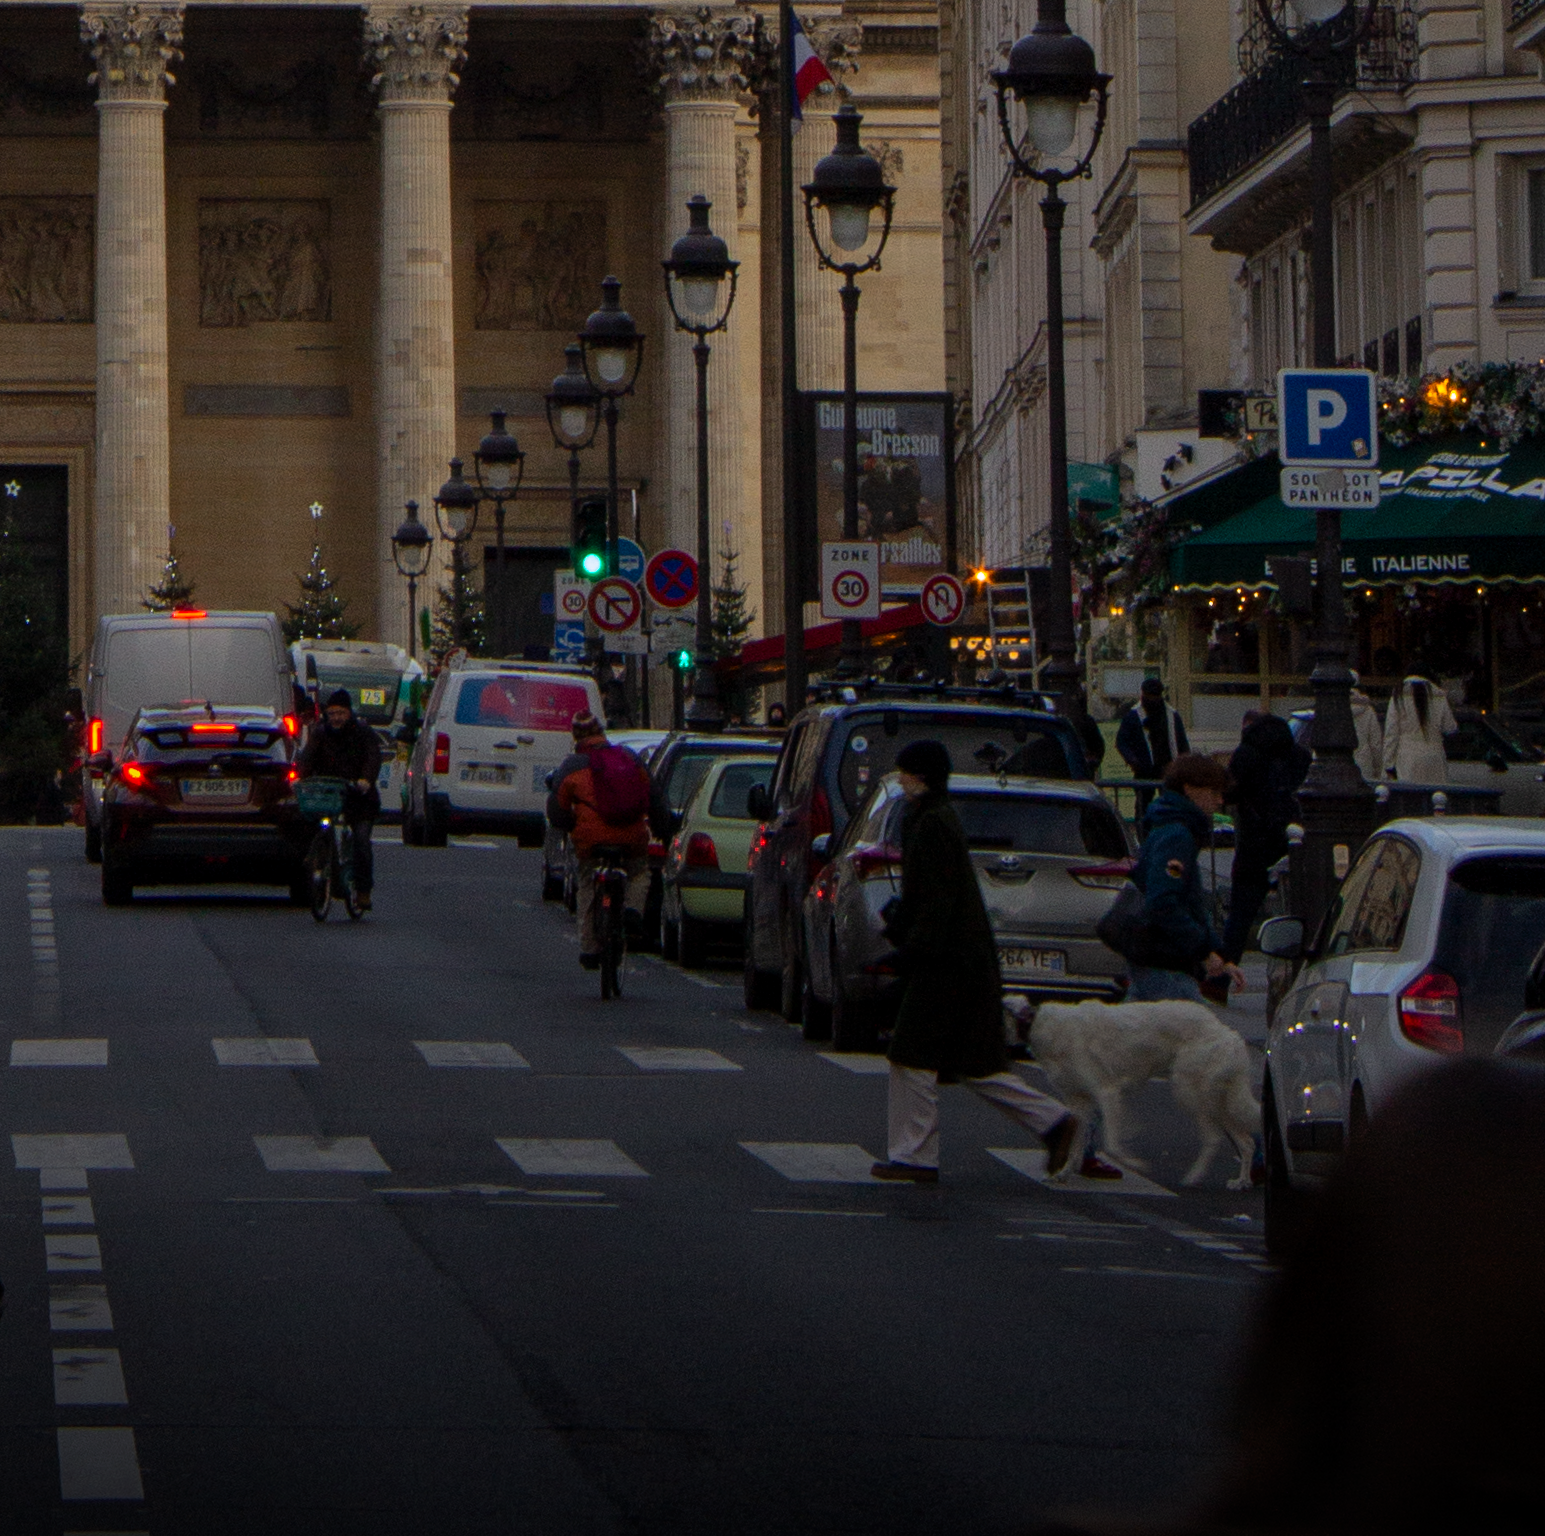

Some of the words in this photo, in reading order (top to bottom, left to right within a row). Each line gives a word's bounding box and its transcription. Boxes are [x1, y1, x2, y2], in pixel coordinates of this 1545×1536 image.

[819, 403, 897, 429] Guiaume
[1306, 388, 1348, 445] P
[871, 429, 940, 457] Bresson
[1290, 473, 1370, 487] SOULOT
[830, 549, 870, 562] ZONE
[880, 537, 942, 564] rsailles
[1372, 554, 1471, 573] ITALIENNE
[839, 580, 863, 597] 30
[567, 595, 582, 607] 30
